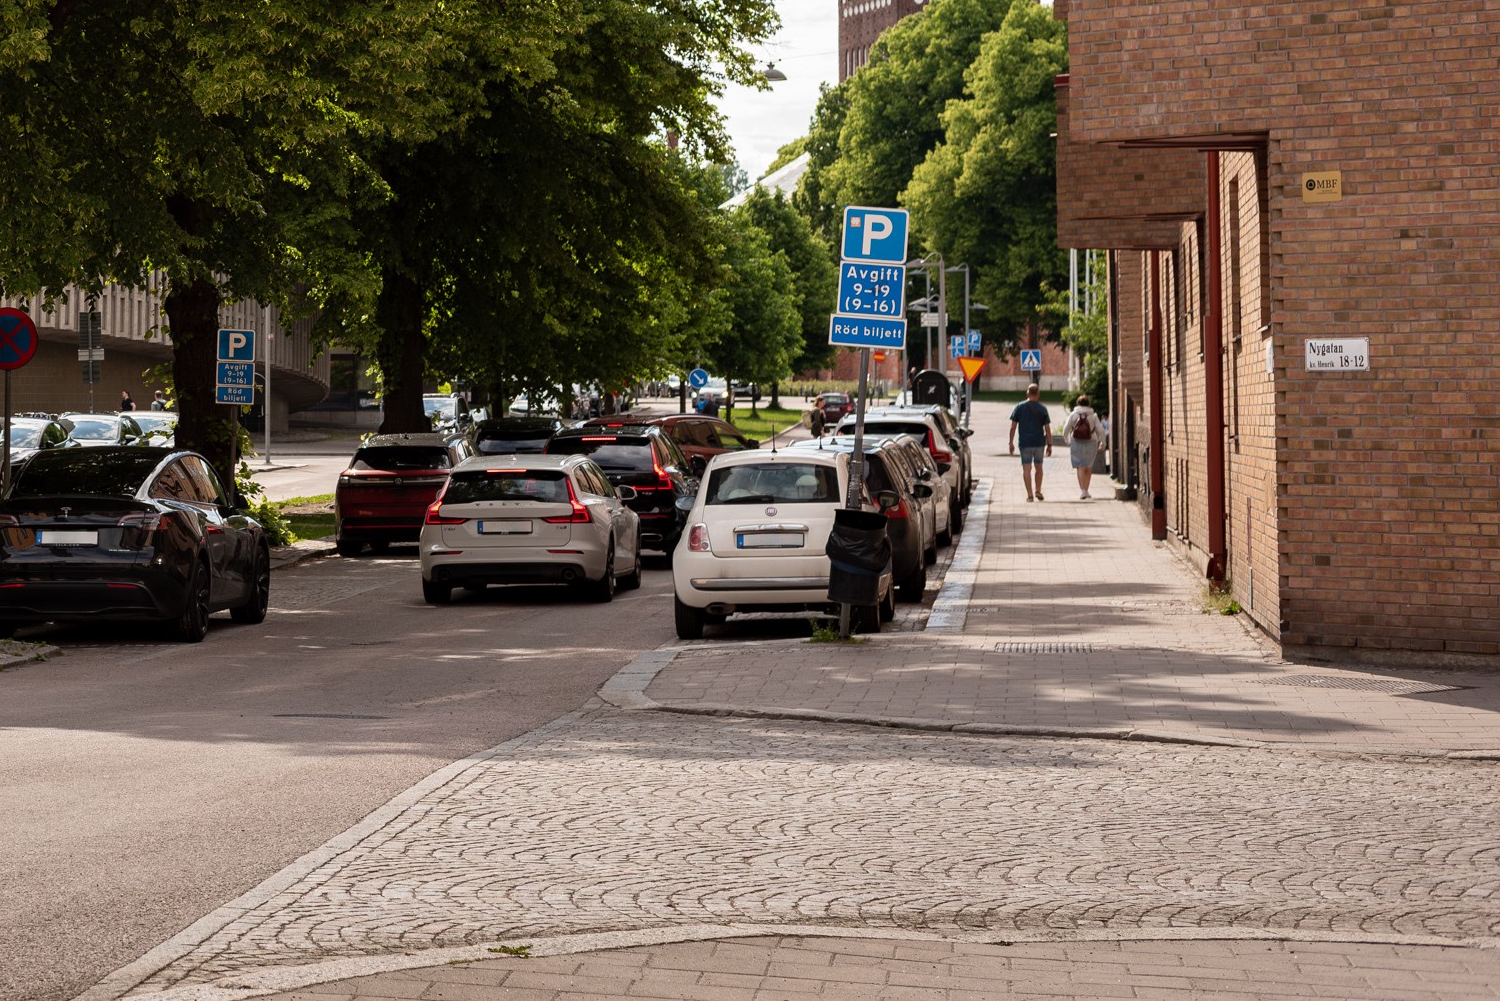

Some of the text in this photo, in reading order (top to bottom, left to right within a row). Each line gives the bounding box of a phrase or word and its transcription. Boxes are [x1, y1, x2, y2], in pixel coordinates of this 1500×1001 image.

[1317, 179, 1338, 189] MBF
[862, 214, 892, 255] P
[847, 266, 899, 283] Avgift
[853, 283, 890, 297] 9-19
[845, 296, 896, 314] (9-16)
[834, 324, 902, 339] Röd biljett
[228, 333, 247, 358] P
[1309, 342, 1344, 356] Nygatan
[224, 363, 248, 371] Avgift
[1340, 355, 1365, 368] 18-12
[223, 394, 247, 402] biljett
